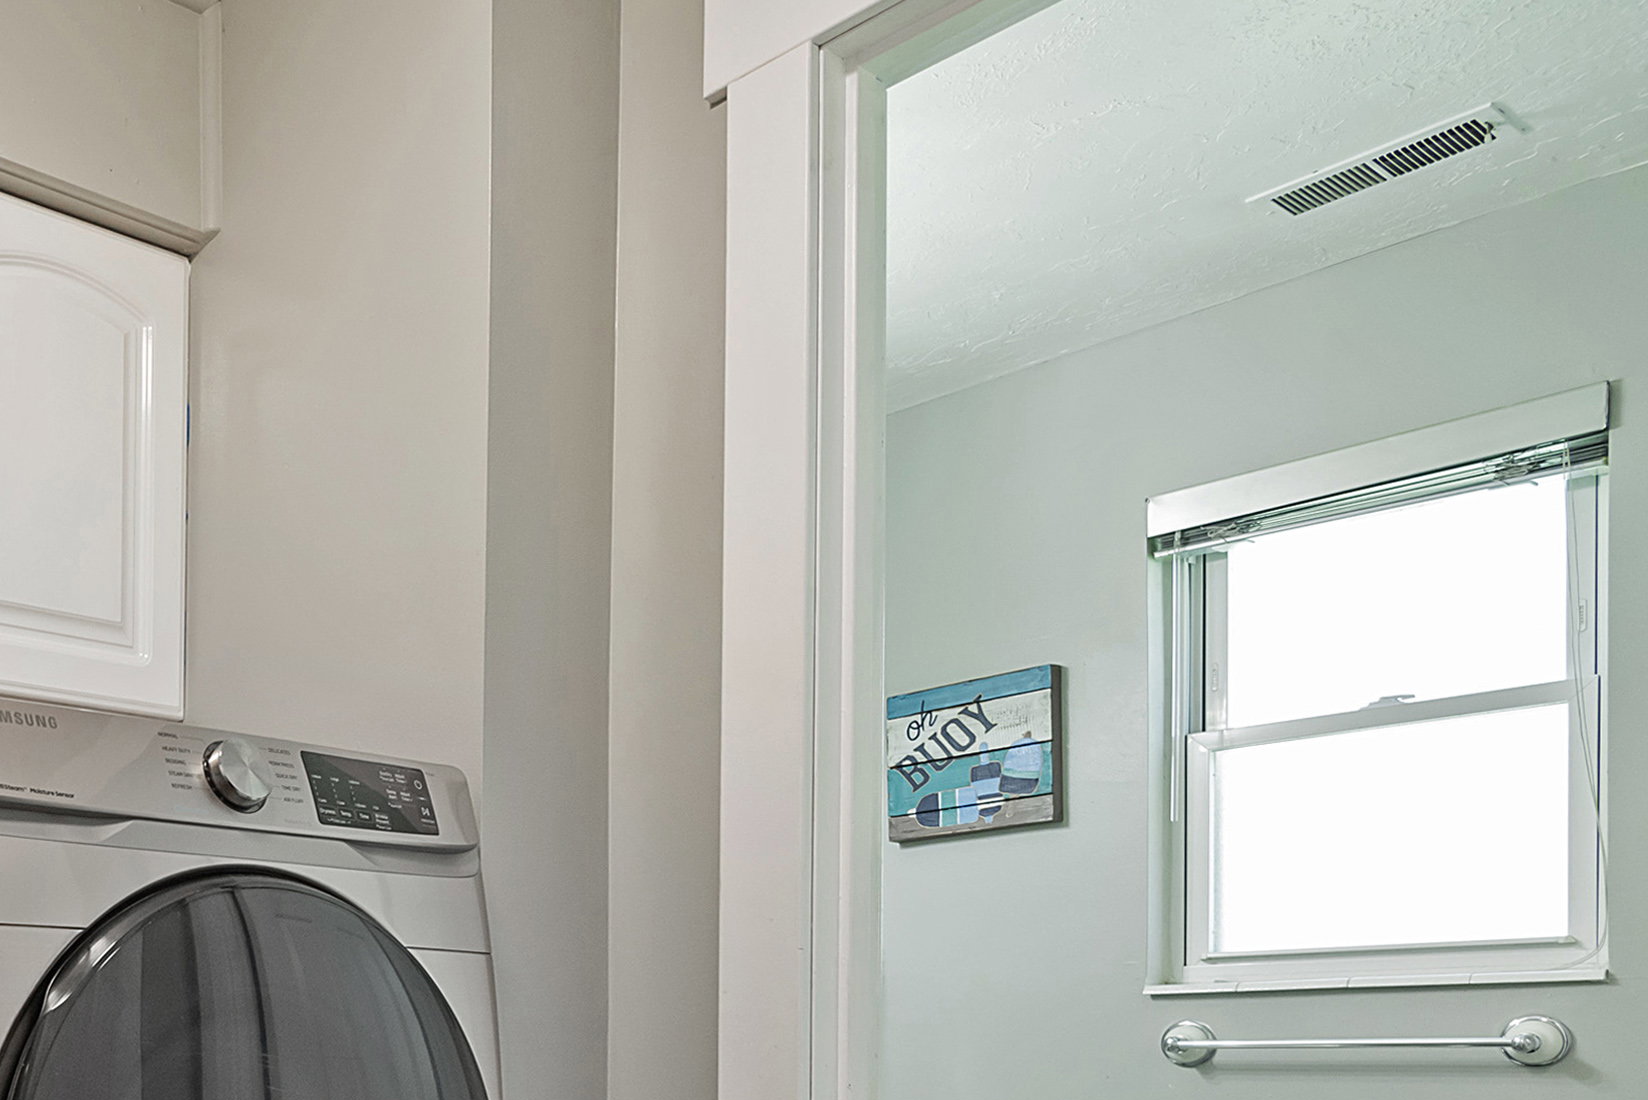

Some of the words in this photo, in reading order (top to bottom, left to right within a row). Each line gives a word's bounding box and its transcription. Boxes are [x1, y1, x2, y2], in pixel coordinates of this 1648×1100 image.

[906, 699, 939, 742] oh
[895, 694, 998, 793] BUOY
[30, 787, 54, 796] Moisture
[55, 791, 74, 799] Sensor
